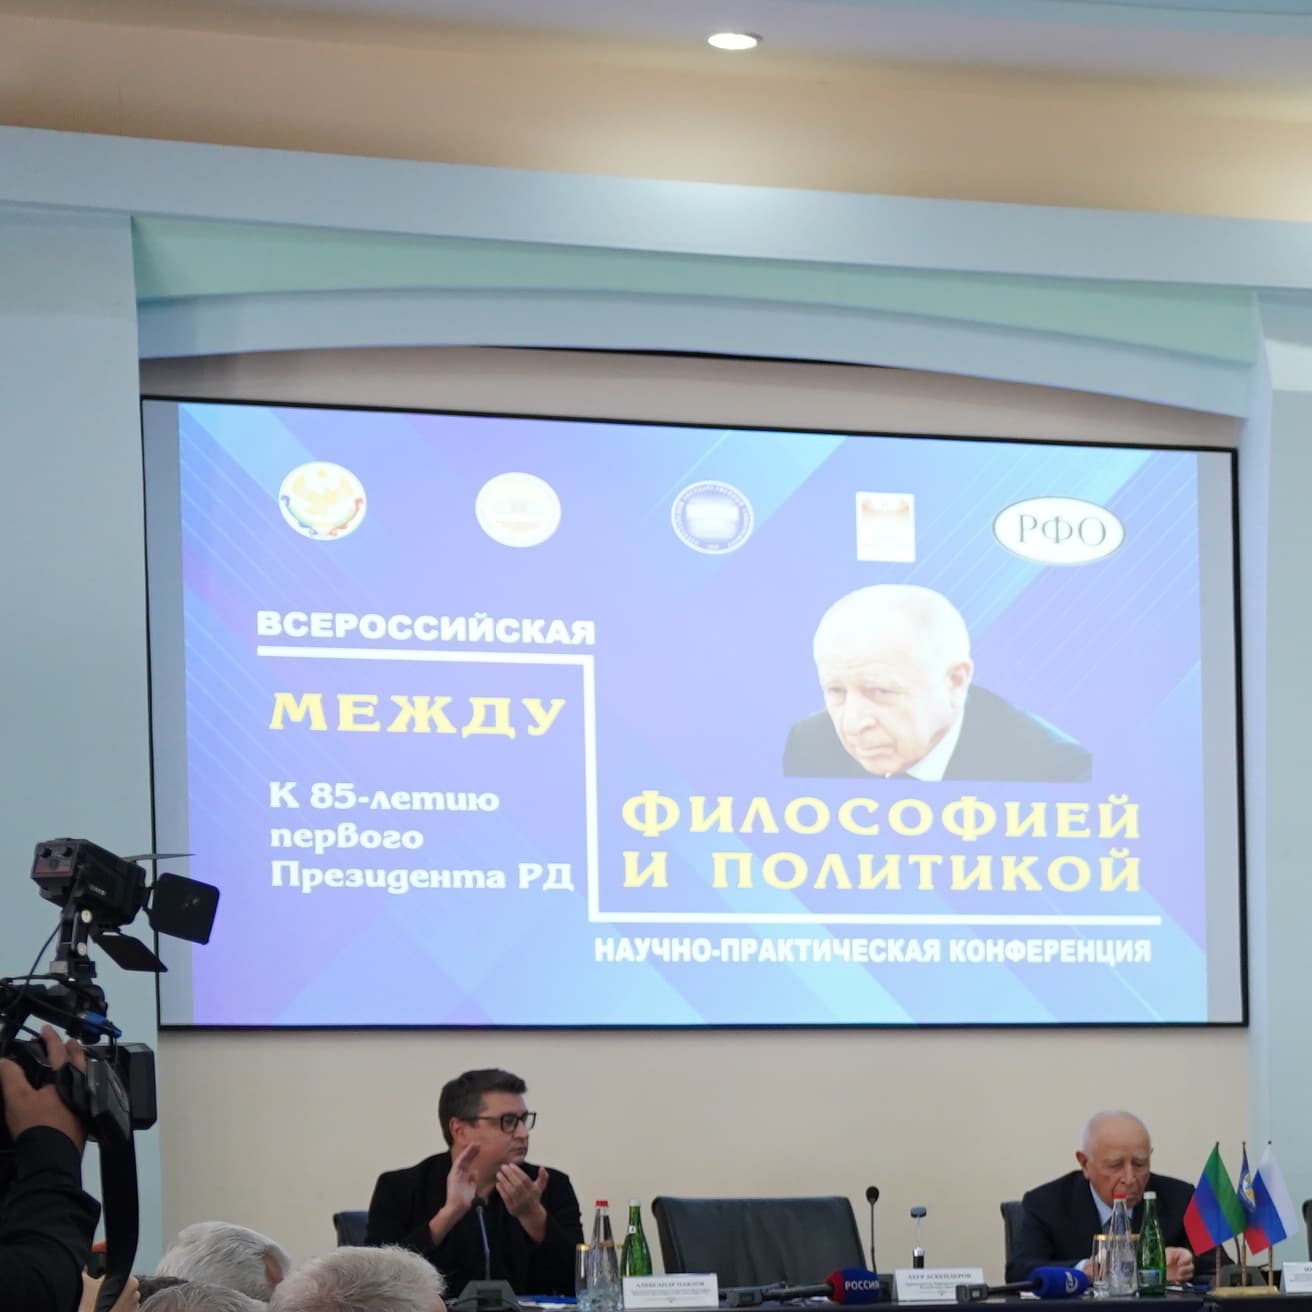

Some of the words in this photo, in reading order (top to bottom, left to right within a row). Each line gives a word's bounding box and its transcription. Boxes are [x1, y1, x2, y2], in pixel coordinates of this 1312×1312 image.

[1018, 513, 1107, 546] РФО
[256, 610, 595, 645] ВСЕРОССИЙСКАЯ
[269, 692, 567, 740] МЕЖДУ
[269, 781, 300, 809] К
[309, 782, 500, 811] 85-летию
[621, 790, 1141, 842] ФИЛОСОФИЕЙ
[270, 822, 424, 855] первого
[271, 860, 506, 895] Президента
[518, 862, 575, 893] РД
[622, 850, 669, 888] И
[711, 847, 1141, 893] ПОЛИТИКОЙ
[594, 936, 941, 963] НАУЧНО-ПРАКТИЧЕСКАЯ
[949, 939, 1152, 967] КОНФЕРЕНЦИЯ
[844, 1279, 880, 1292] РОССИЯ
